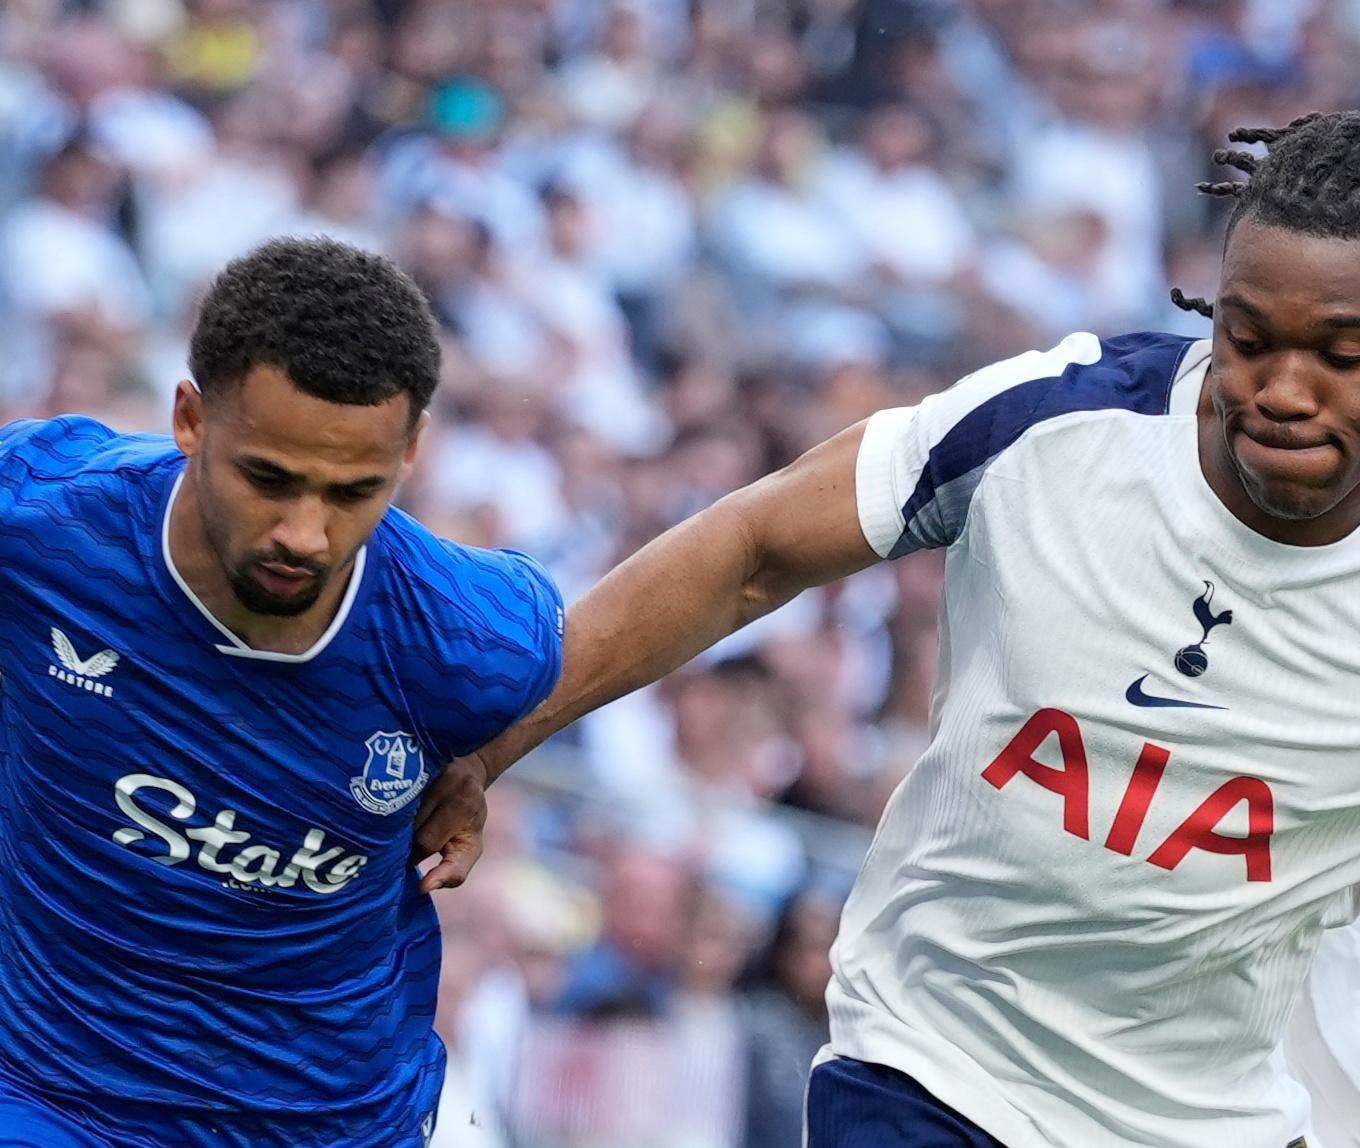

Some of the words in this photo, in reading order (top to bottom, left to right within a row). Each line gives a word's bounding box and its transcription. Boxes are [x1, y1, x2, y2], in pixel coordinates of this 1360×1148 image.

[48, 664, 114, 698] CASTORE
[112, 773, 368, 894] Stake
[980, 706, 1274, 883] AIA
